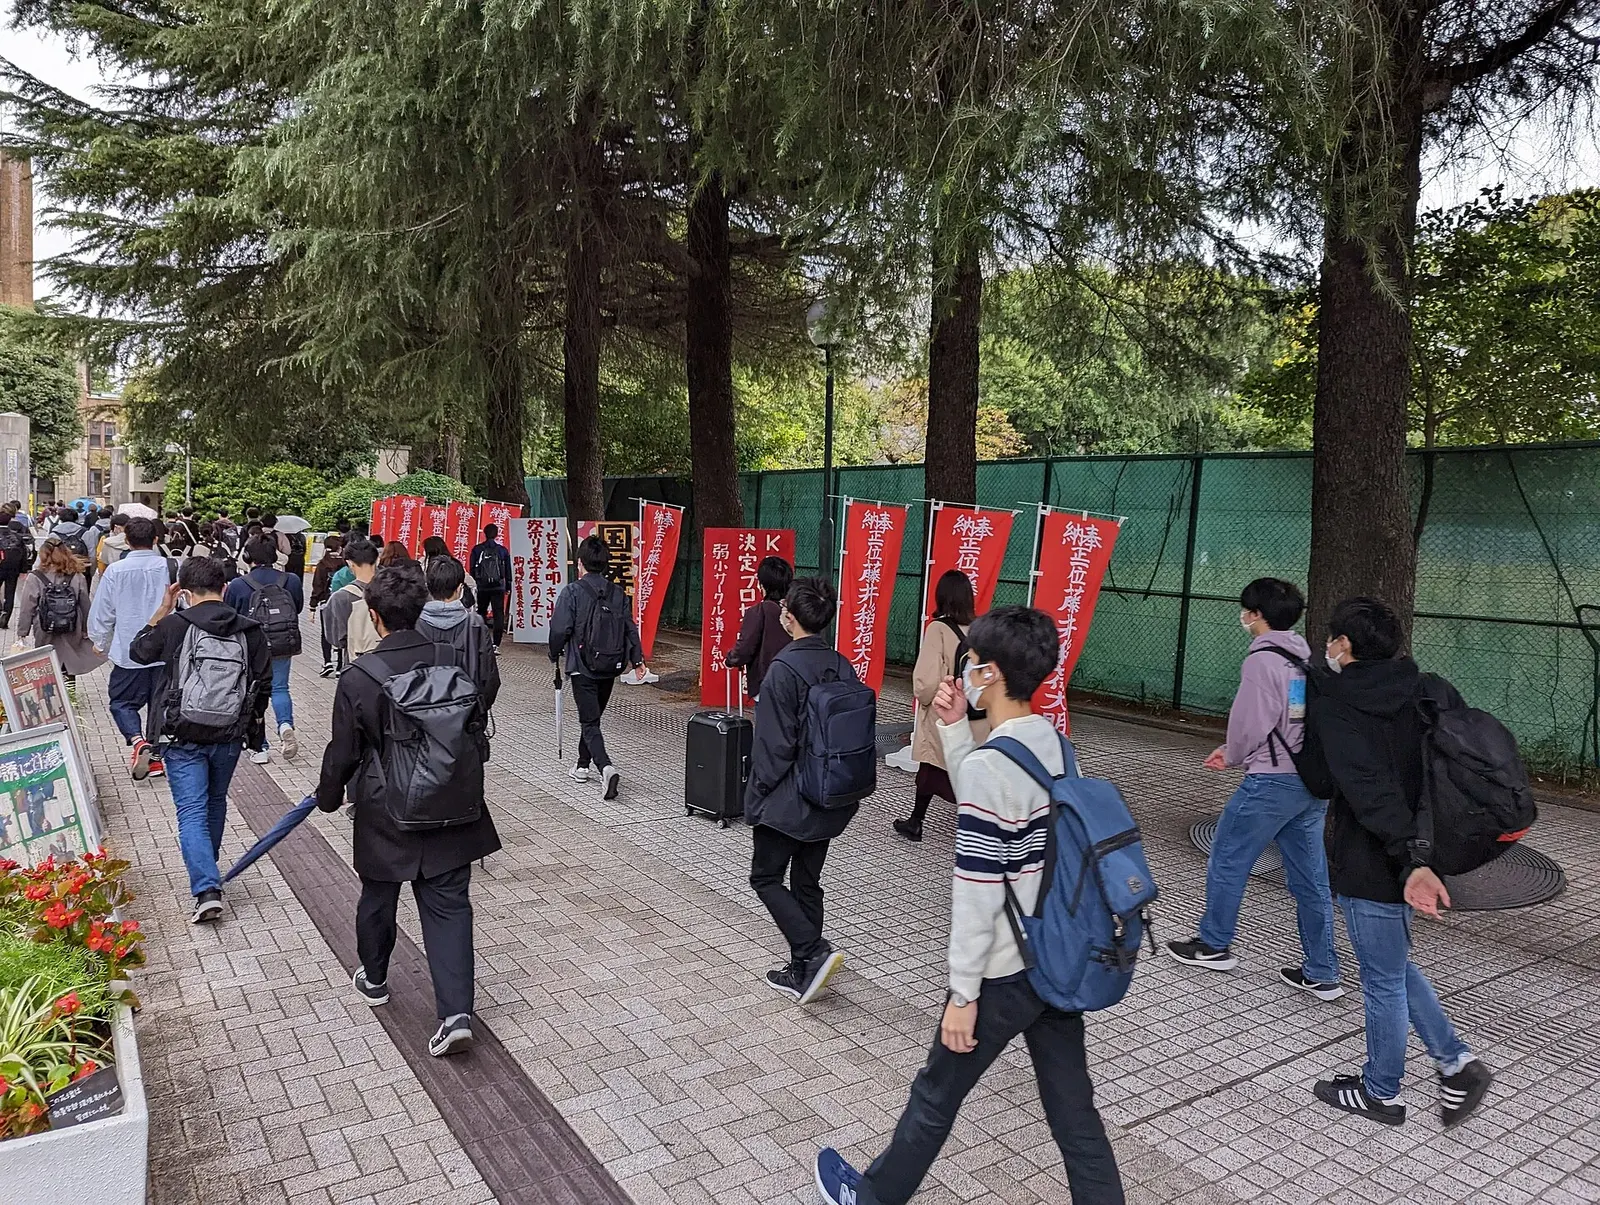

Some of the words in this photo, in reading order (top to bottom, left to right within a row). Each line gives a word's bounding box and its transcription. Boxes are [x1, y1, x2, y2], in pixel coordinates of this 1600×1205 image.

[527, 519, 545, 628] 祭りを学生の手に
[710, 543, 730, 672] 弱小サークル潰す気か
[851, 529, 885, 685] 正一位藤井稲荷大明
